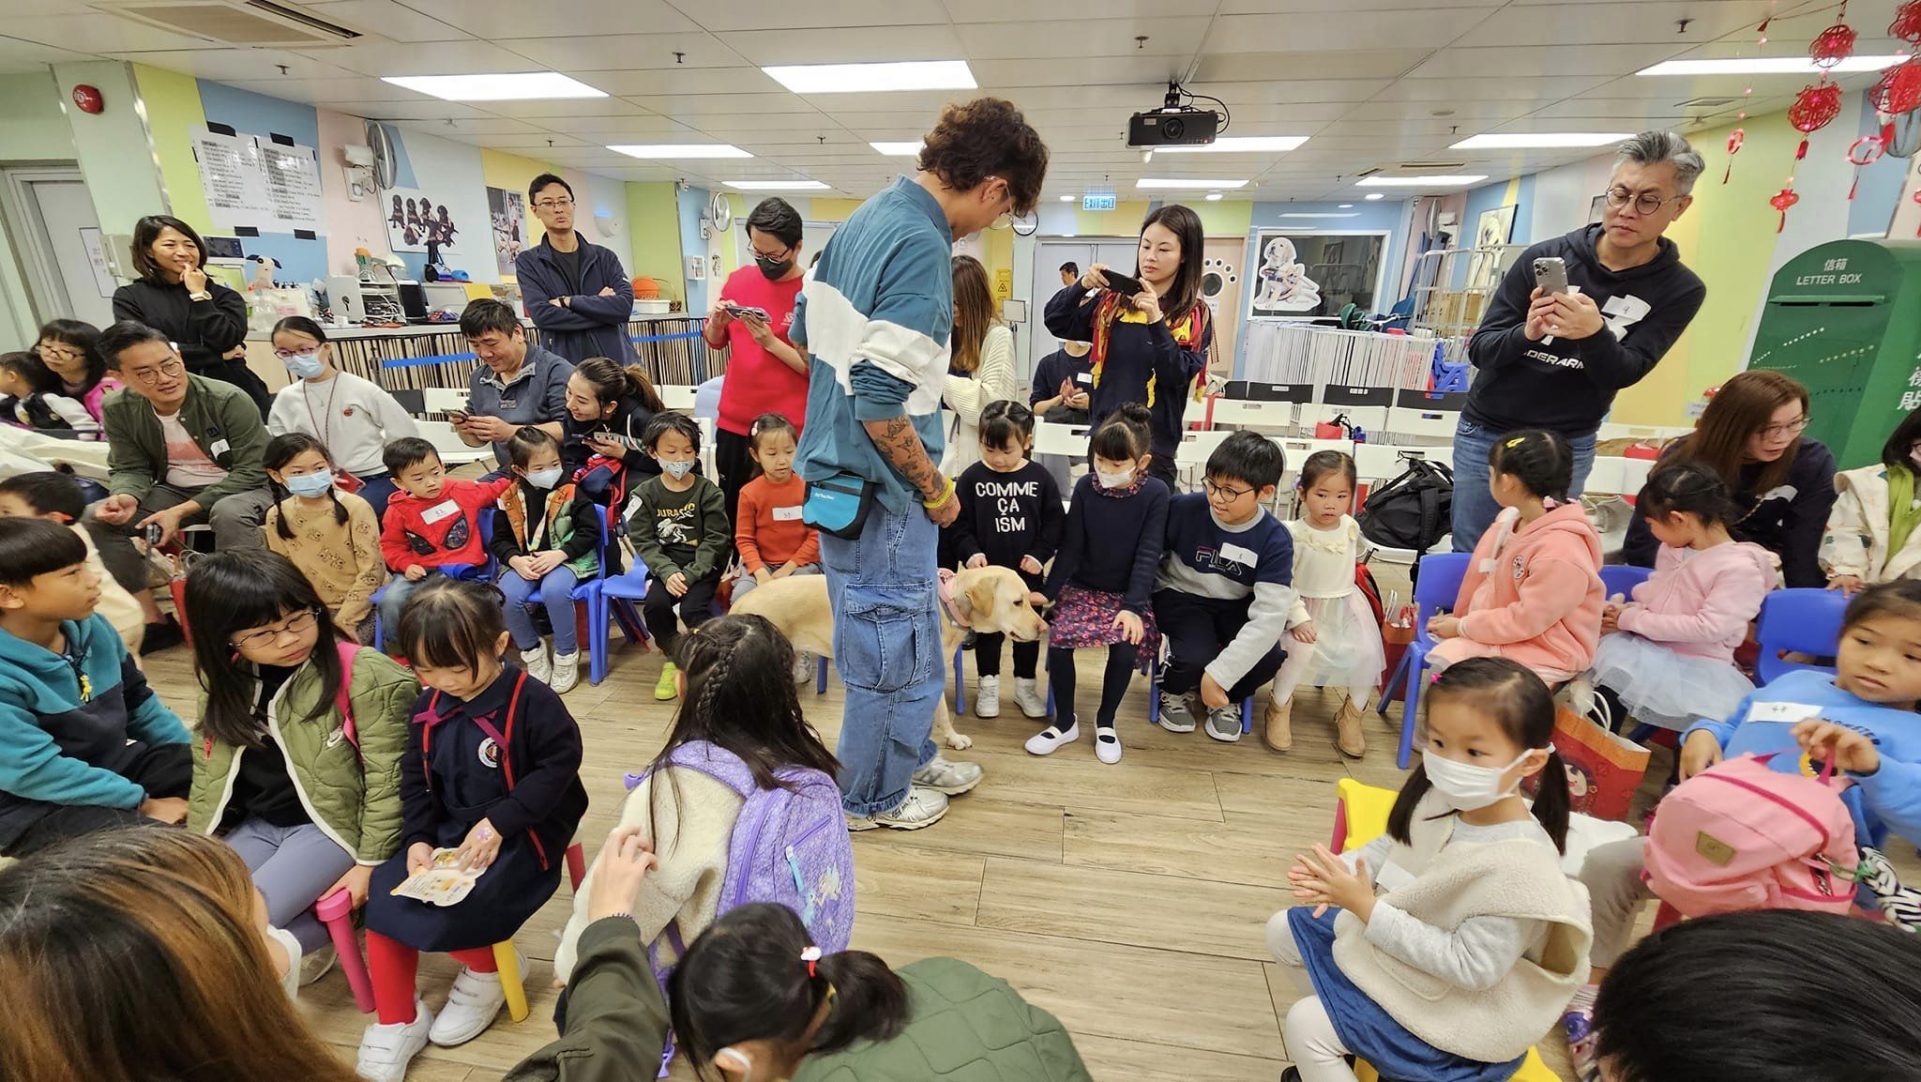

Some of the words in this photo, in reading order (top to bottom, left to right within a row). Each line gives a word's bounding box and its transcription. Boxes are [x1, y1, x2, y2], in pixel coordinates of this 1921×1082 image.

[1824, 258, 1848, 271] 信箱
[1796, 274, 1836, 286] LETTER
[1839, 273, 1863, 284] BOX
[975, 481, 1039, 498] COMME
[997, 497, 1020, 516] ÇA
[995, 516, 1026, 533] ISM
